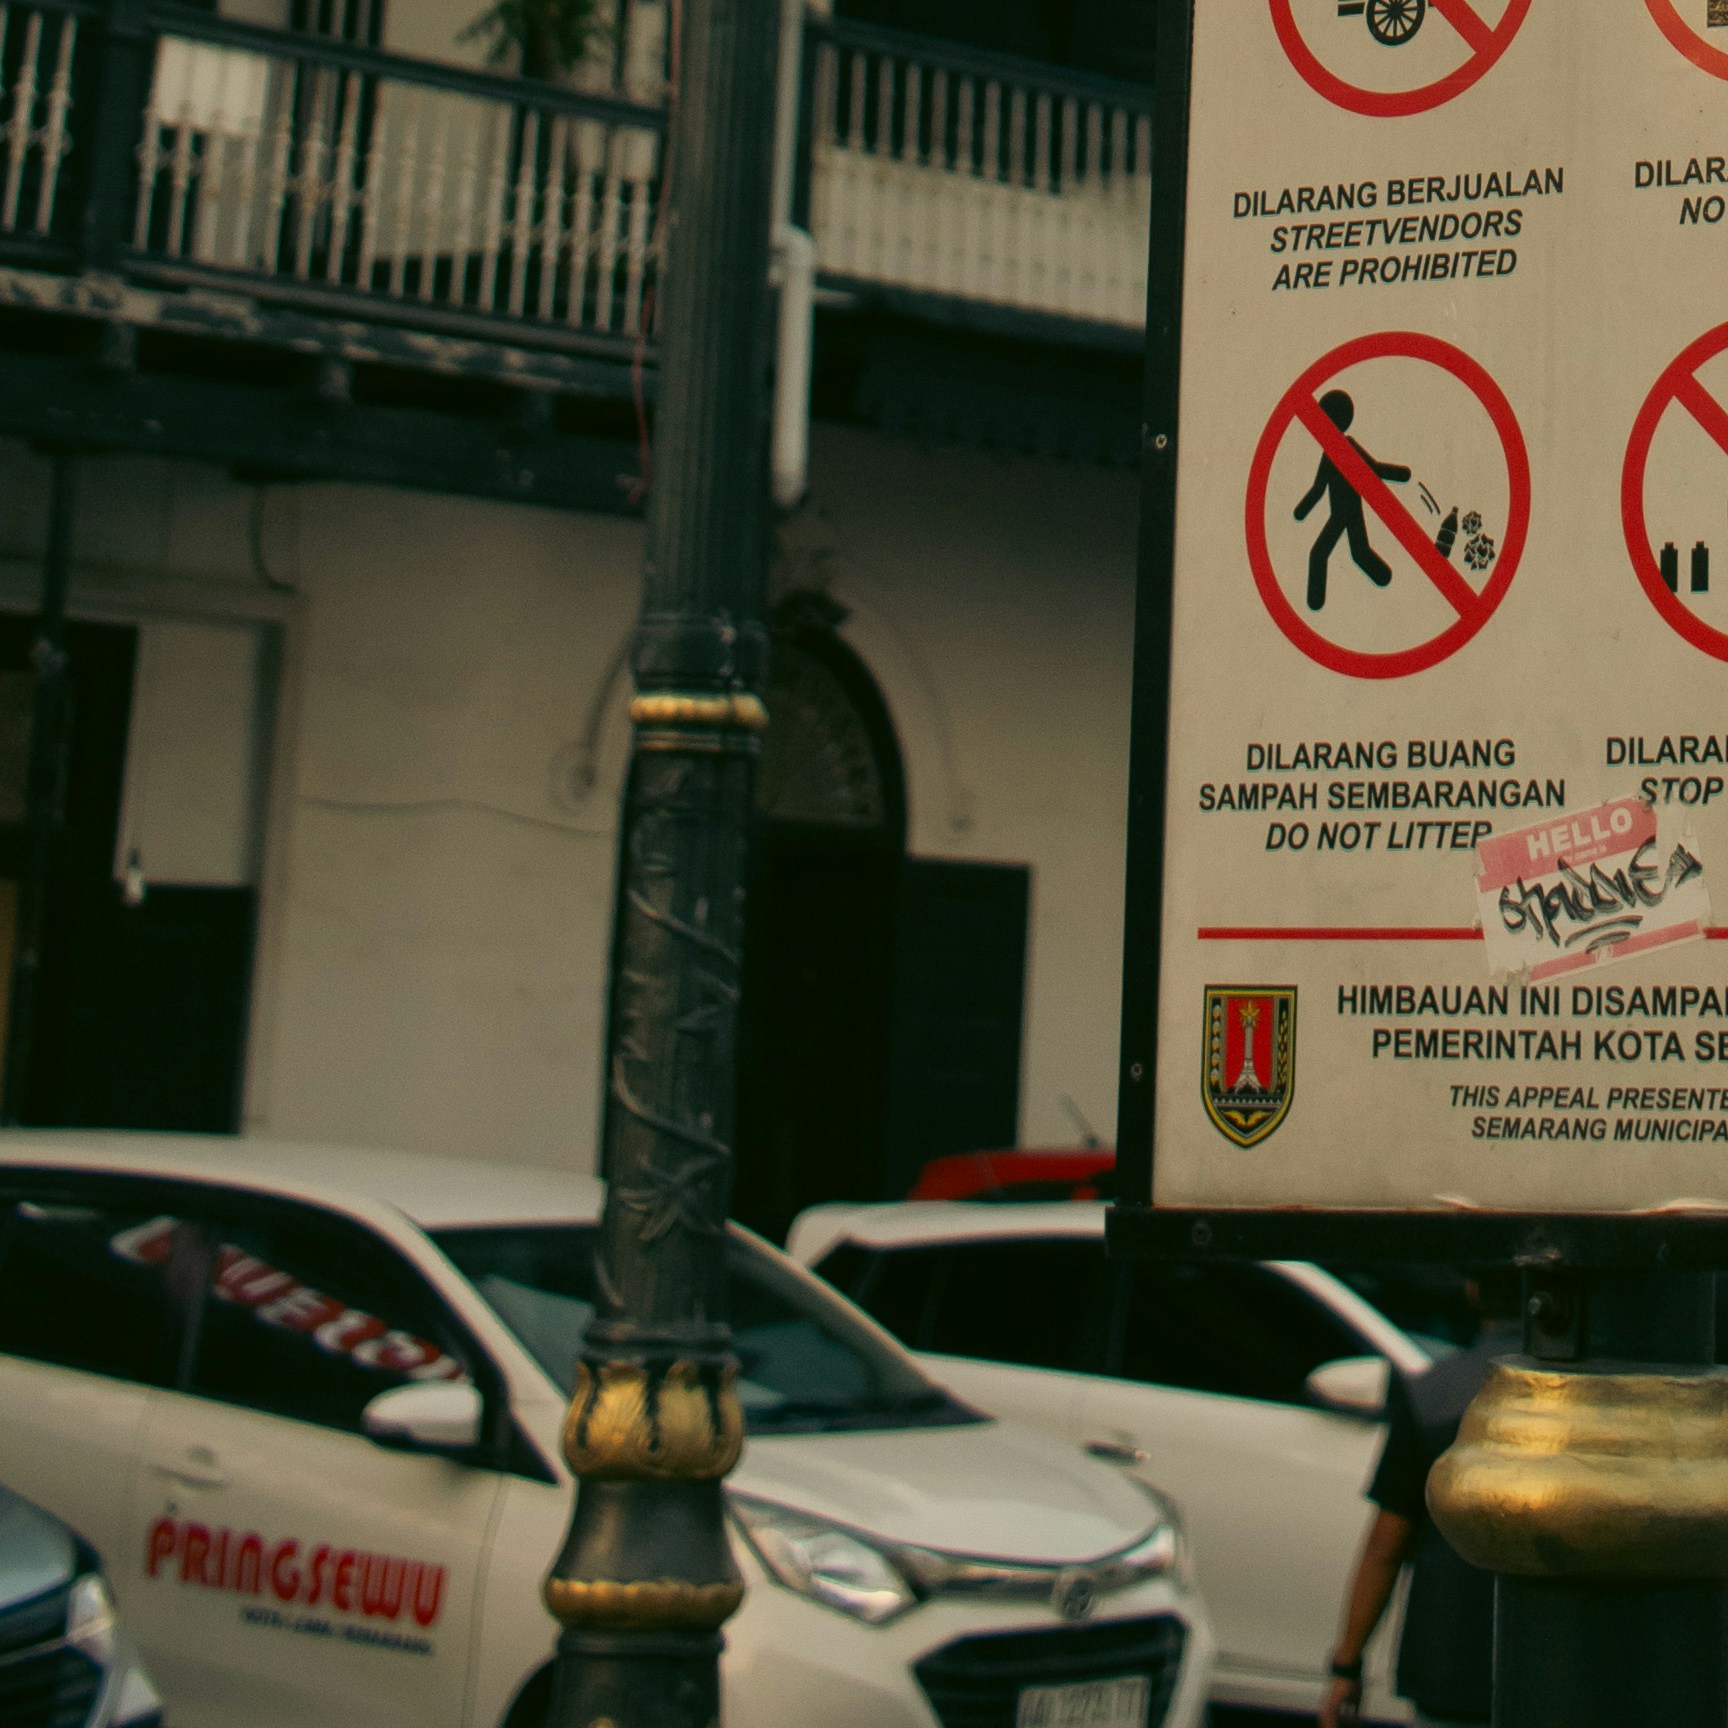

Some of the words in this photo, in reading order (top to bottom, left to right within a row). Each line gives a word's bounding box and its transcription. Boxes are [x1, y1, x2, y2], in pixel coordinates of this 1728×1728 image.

[1233, 181, 1377, 219] DILARANG
[1386, 167, 1564, 206] BERJUALAN
[1679, 195, 1726, 225] NO
[1269, 208, 1524, 254] STREETVENDORS
[1271, 260, 1334, 291] ARE
[1338, 248, 1518, 286] PROHIBITED
[1246, 741, 1398, 771] DILARANG
[1407, 738, 1516, 769] BUANG
[1198, 782, 1318, 811] SAMPAH
[1327, 778, 1565, 810] SEMBARANGAN
[1640, 776, 1725, 809] STOP
[1265, 822, 1310, 851] DO
[1316, 821, 1382, 850] NOT
[1386, 820, 1493, 850] LITTER
[1526, 807, 1633, 861] HELLO
[1337, 984, 1509, 1016] HIMBAUAN
[1520, 985, 1560, 1017] INI
[1372, 1028, 1582, 1061] PEMERINTAH
[1593, 1030, 1686, 1062] KOTA
[1450, 1084, 1501, 1108] THIS
[1504, 1085, 1600, 1110] APPEAL
[1471, 1115, 1607, 1141] SEMARANG
[146, 1517, 446, 1627] PRINGSEWU
